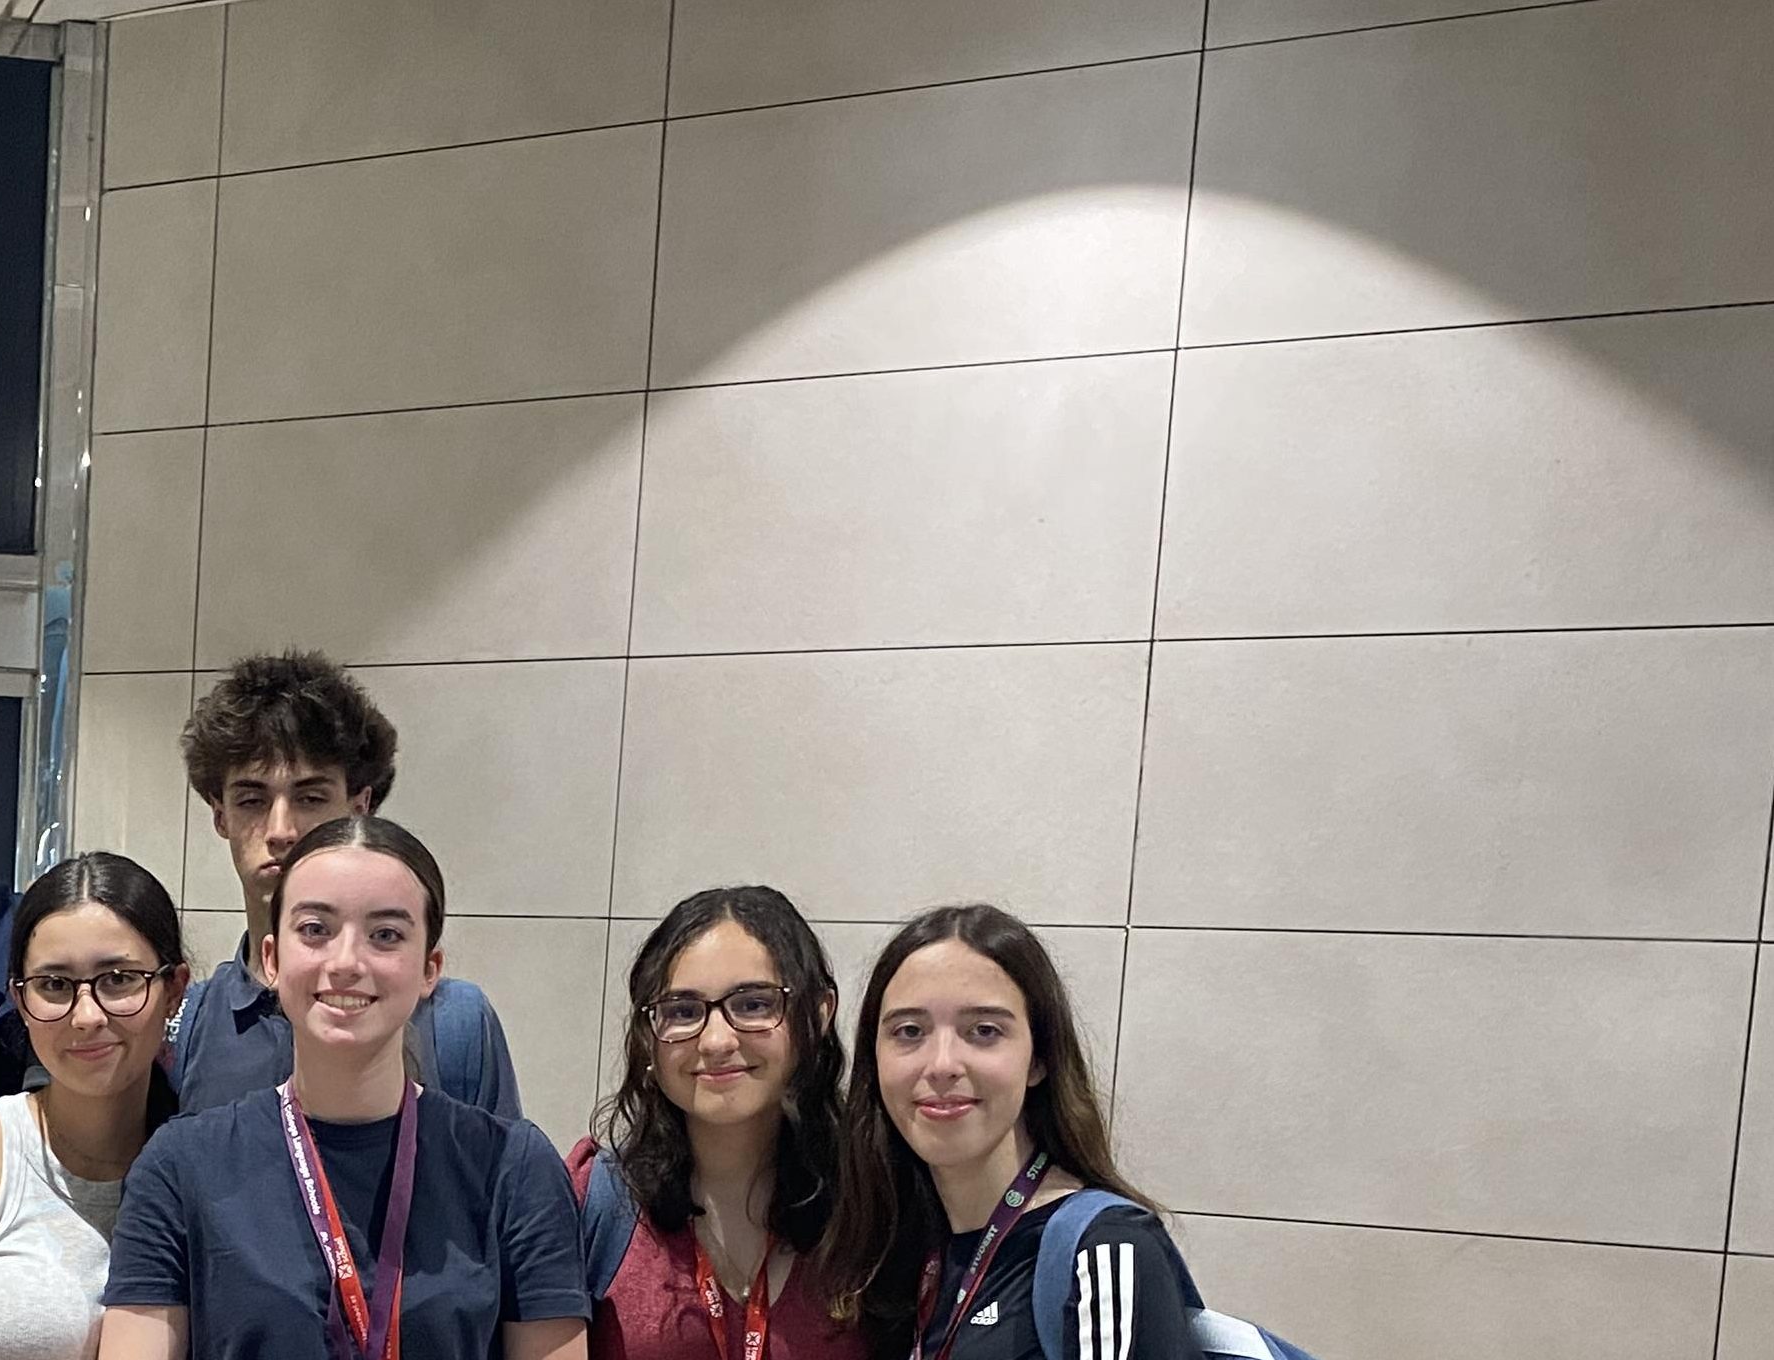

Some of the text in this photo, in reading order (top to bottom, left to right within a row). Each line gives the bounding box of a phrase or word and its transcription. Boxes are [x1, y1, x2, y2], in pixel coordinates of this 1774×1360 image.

[284, 1103, 321, 1216] College Language Schools
[969, 1223, 999, 1275] STUDENT
